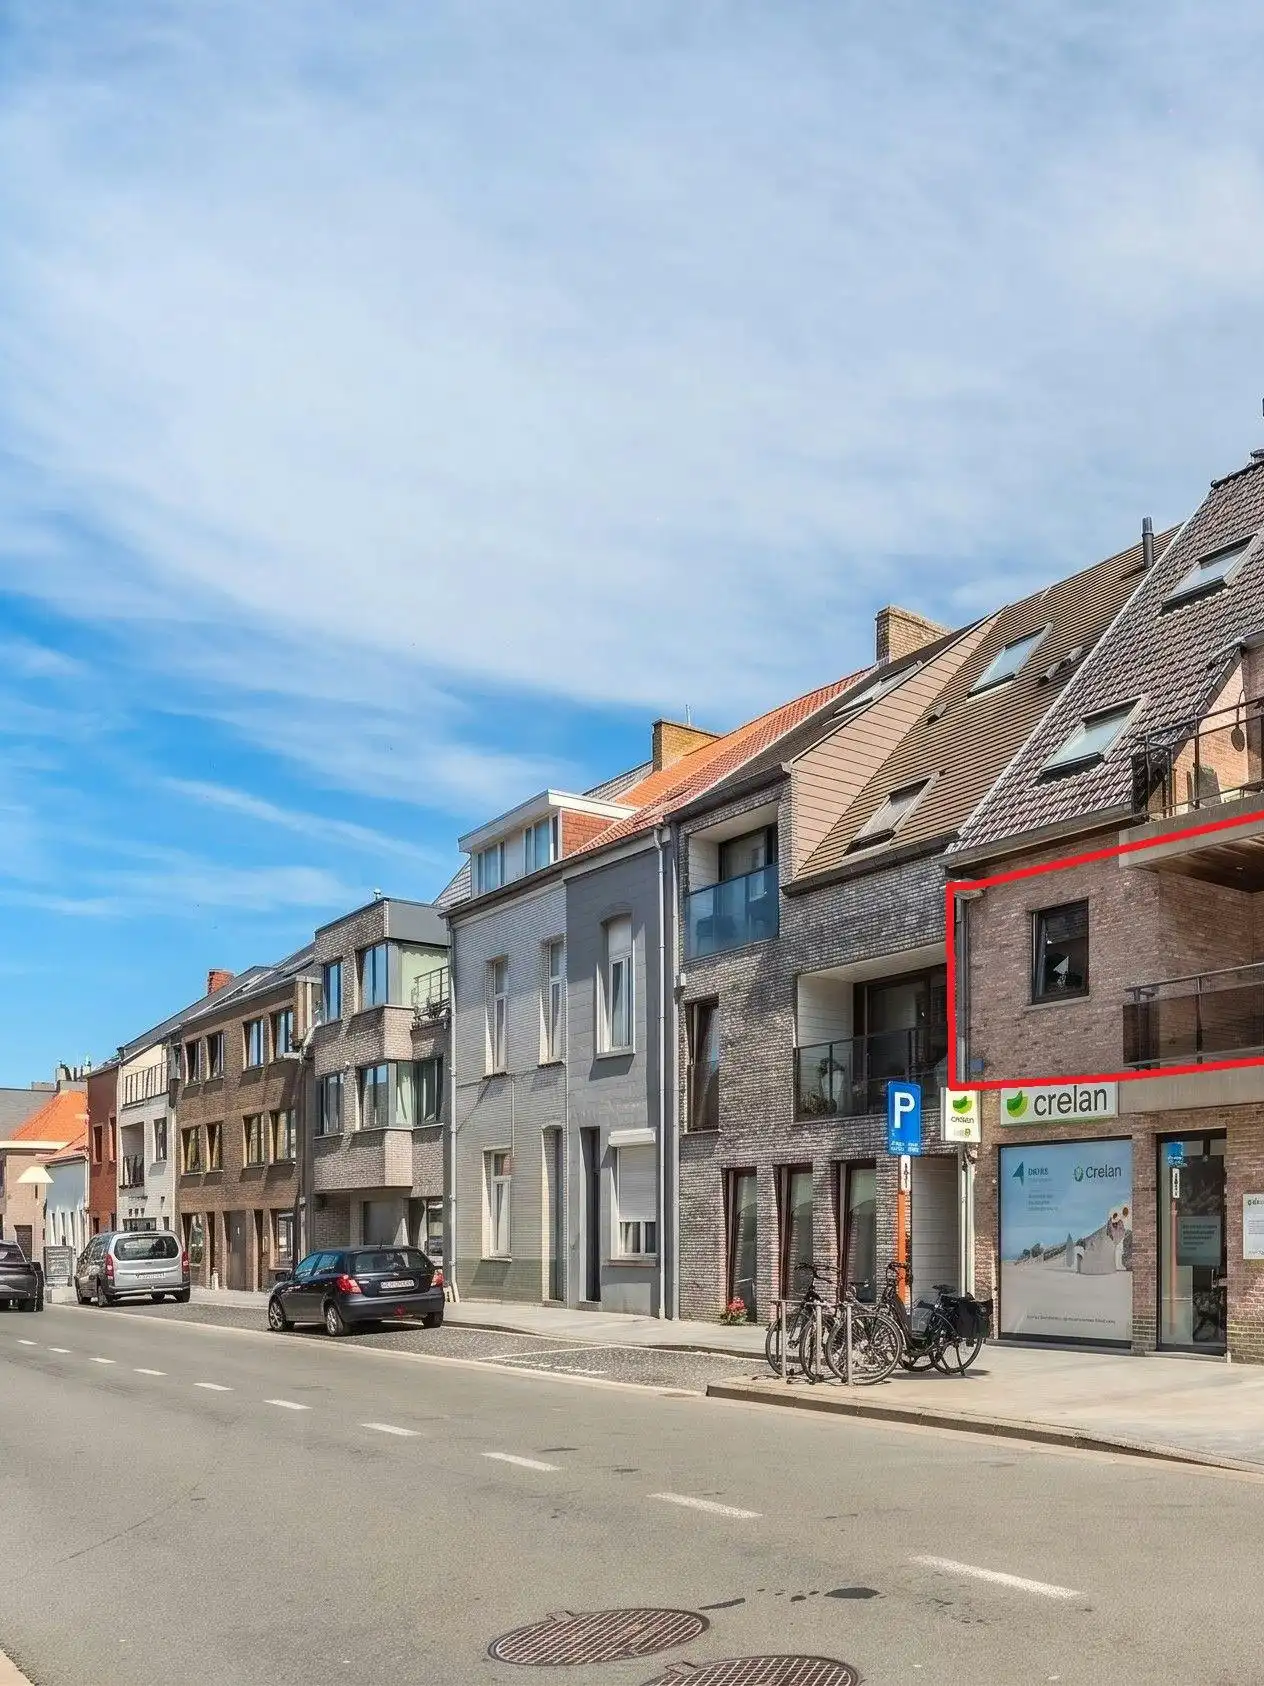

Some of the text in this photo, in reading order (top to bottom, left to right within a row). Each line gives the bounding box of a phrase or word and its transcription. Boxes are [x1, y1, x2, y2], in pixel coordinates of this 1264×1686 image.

[894, 1091, 916, 1129] P
[1034, 1084, 1108, 1116] crelan
[1085, 1164, 1122, 1179] Crelan
